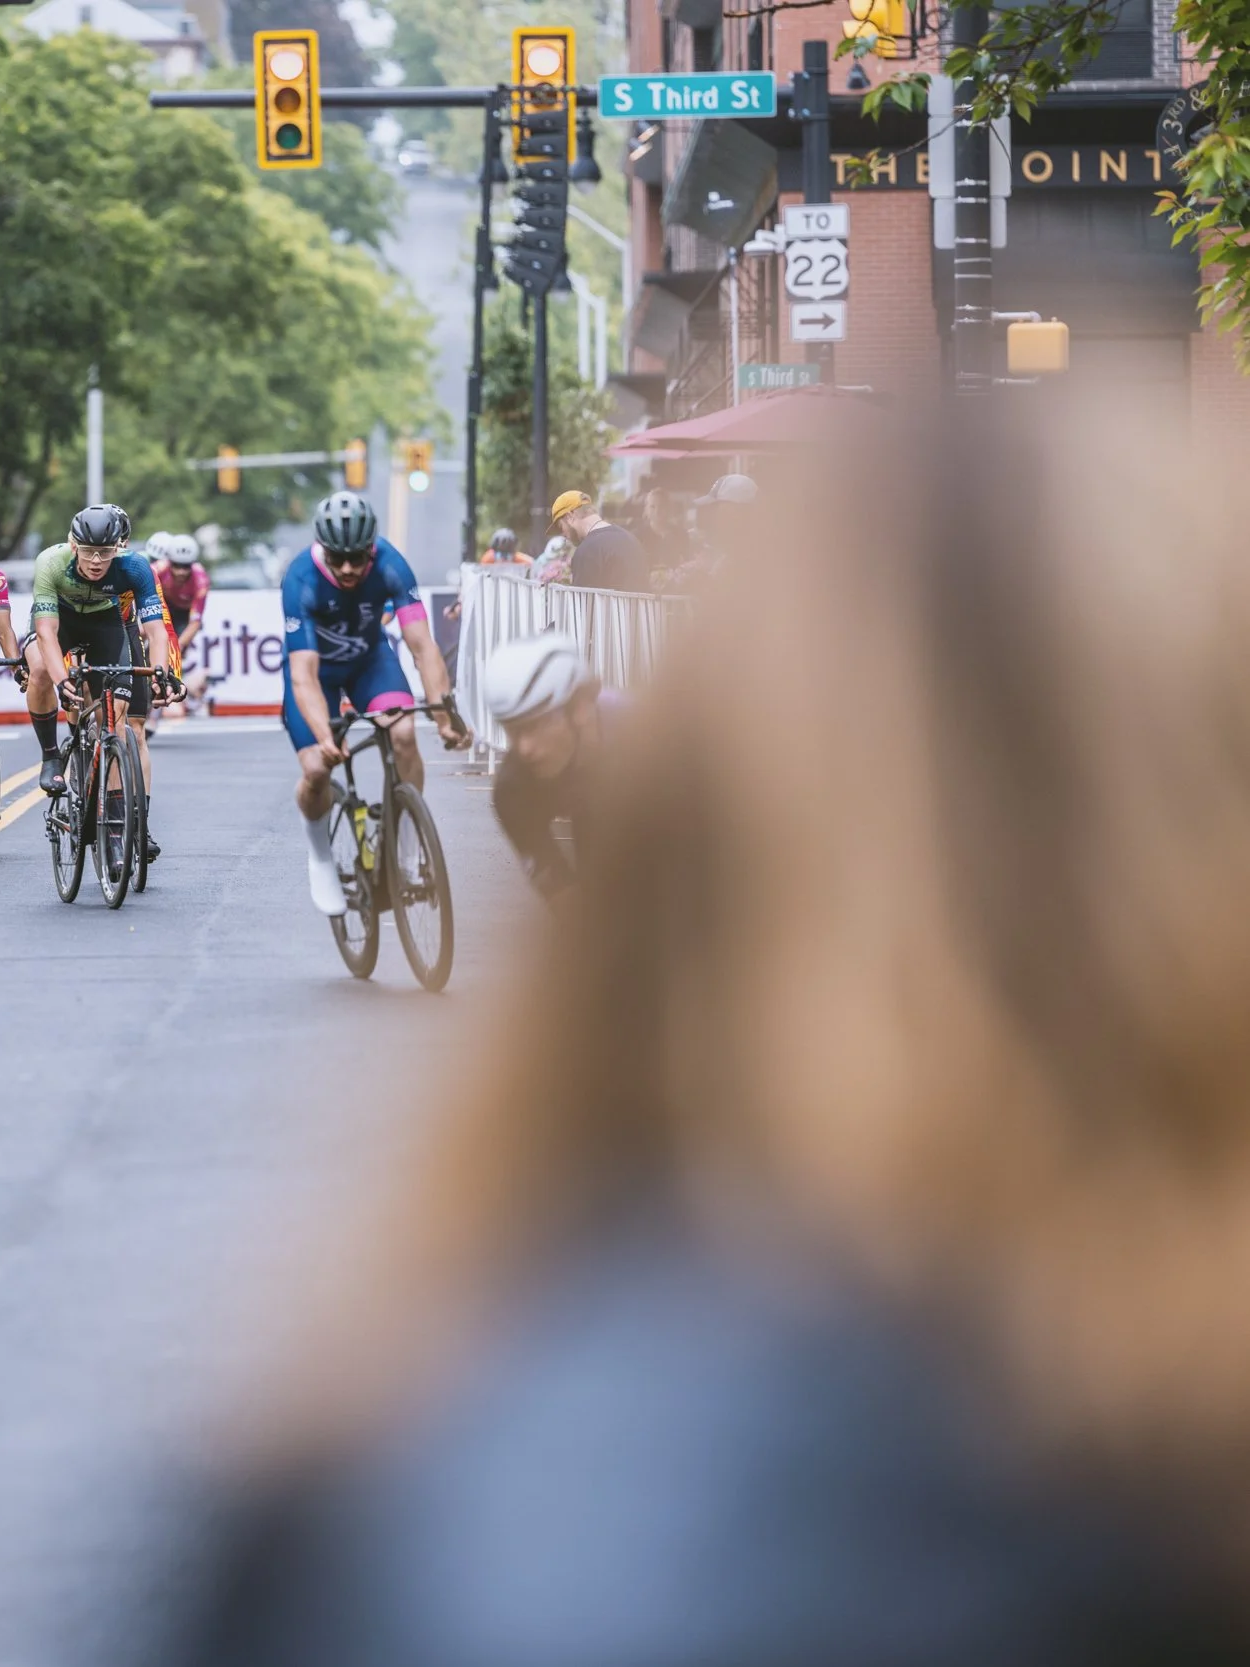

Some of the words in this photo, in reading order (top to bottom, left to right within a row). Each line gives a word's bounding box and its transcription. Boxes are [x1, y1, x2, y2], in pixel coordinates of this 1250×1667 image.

[613, 82, 634, 112] S
[646, 81, 719, 111] Third
[730, 79, 761, 110] St
[1021, 149, 1162, 183] OINT
[802, 212, 831, 231] TO
[793, 255, 842, 286] 22
[760, 367, 794, 386] Third
